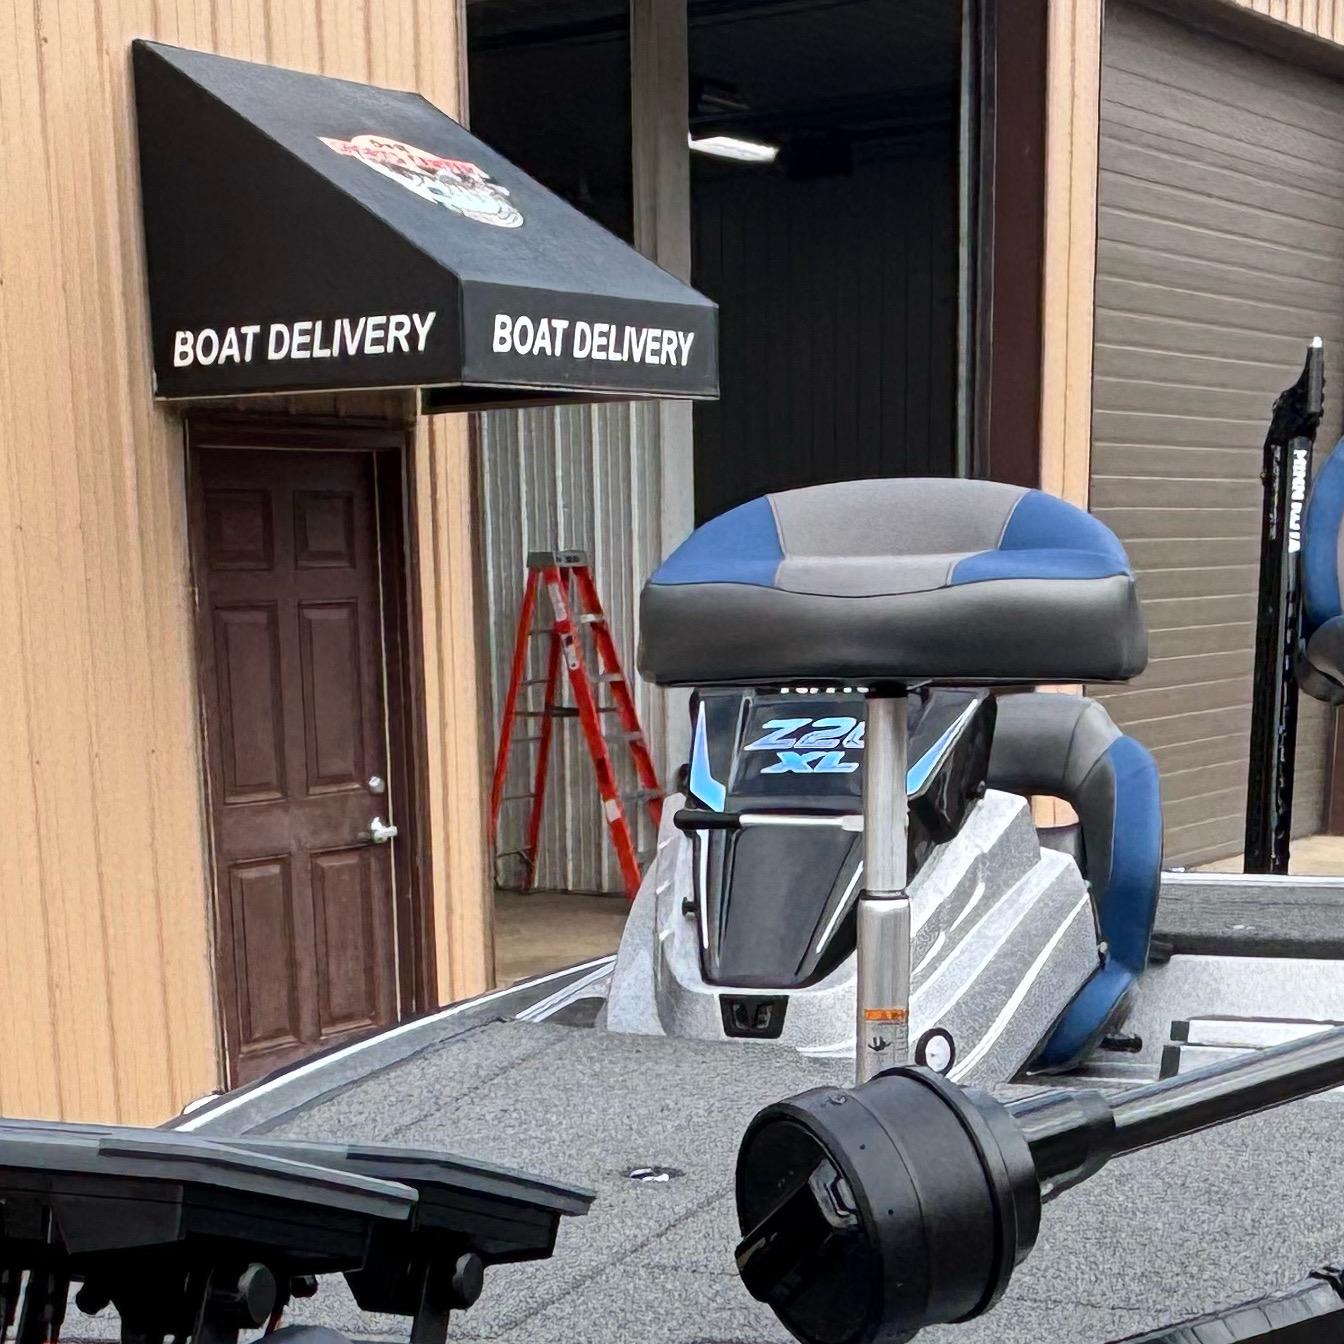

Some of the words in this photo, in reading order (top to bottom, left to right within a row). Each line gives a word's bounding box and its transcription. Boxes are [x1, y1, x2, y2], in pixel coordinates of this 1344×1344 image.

[174, 324, 261, 368] BOAT
[267, 312, 437, 361] DELIVERY
[492, 314, 568, 357] BOAT
[573, 323, 696, 367] DELIVERY
[760, 750, 860, 774] XL
